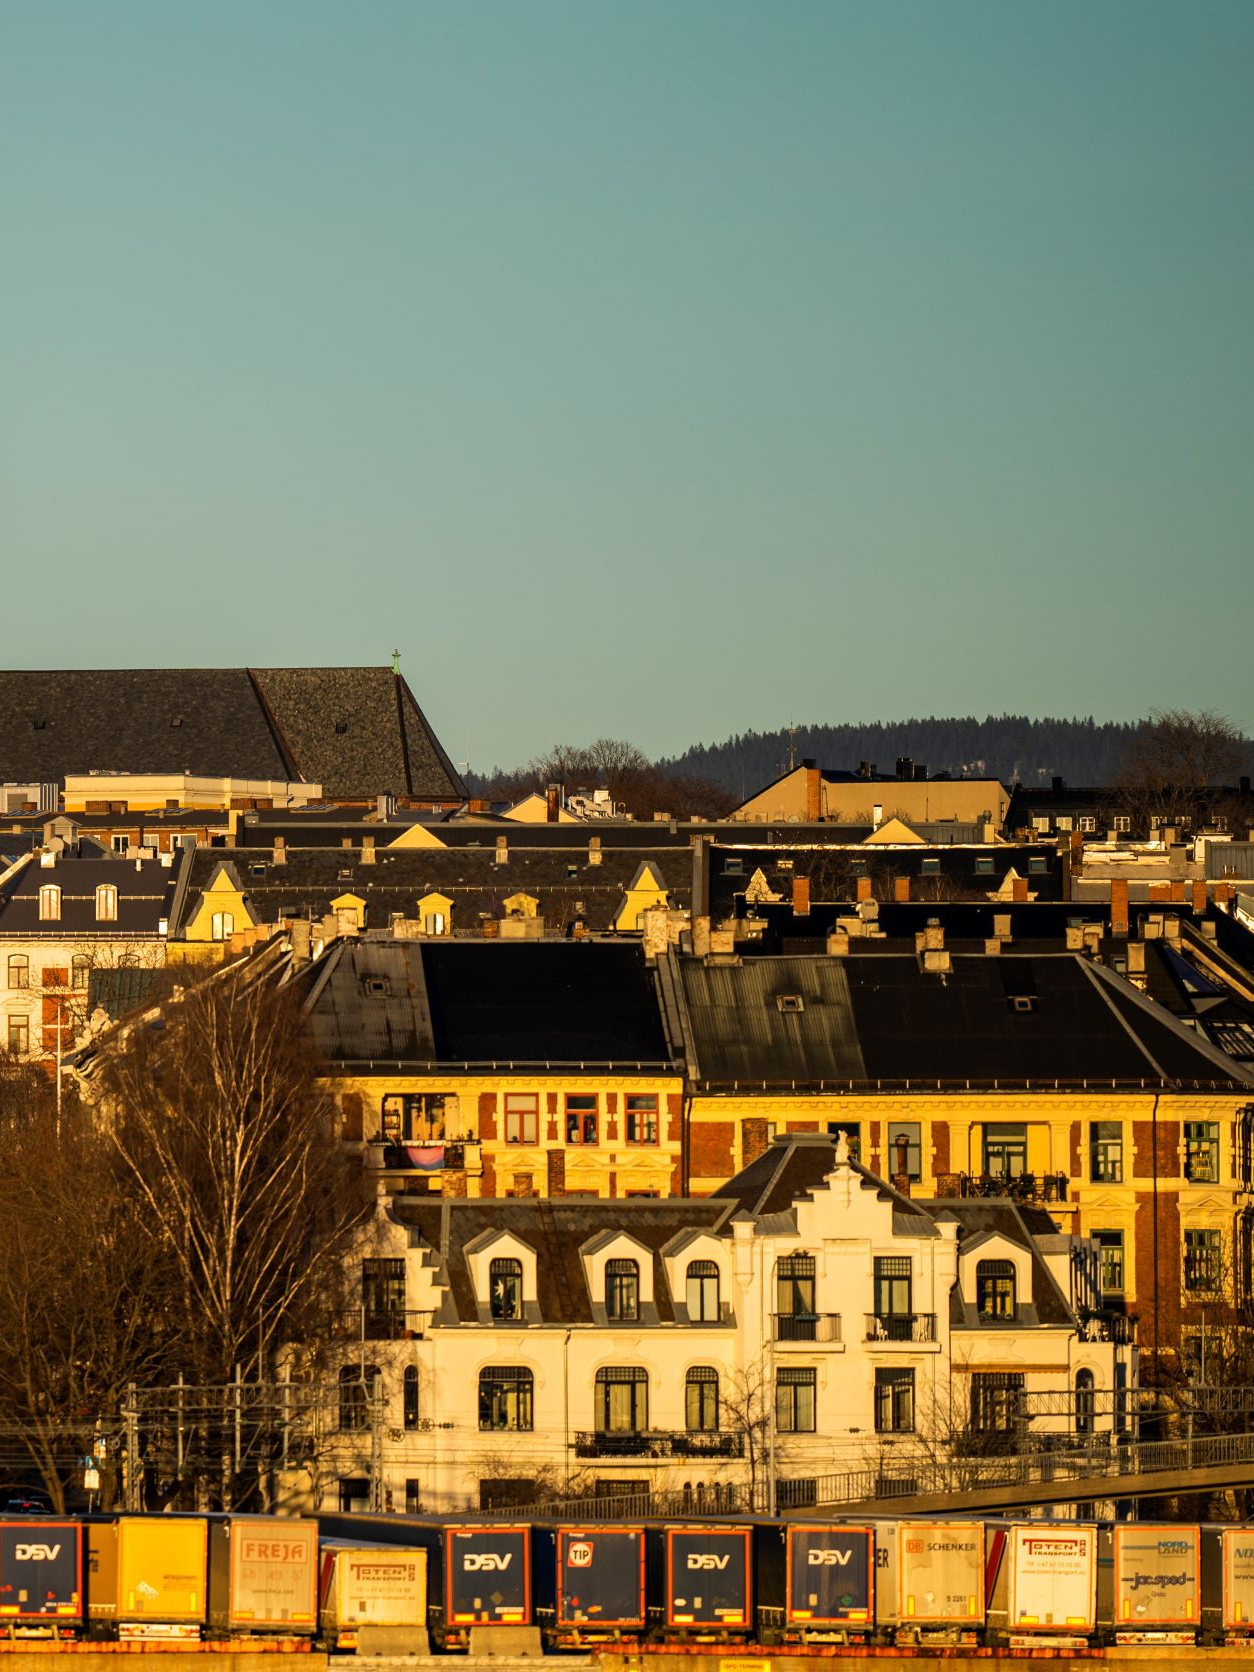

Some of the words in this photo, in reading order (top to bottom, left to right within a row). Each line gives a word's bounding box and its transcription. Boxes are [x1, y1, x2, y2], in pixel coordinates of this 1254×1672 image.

[15, 1544, 62, 1561] DSV
[246, 1543, 303, 1561] FREJA
[572, 1549, 590, 1561] TIP
[927, 1543, 977, 1551] SCHENKER
[463, 1553, 513, 1571] DSV
[687, 1554, 731, 1570] DSV
[808, 1549, 853, 1566] DSV
